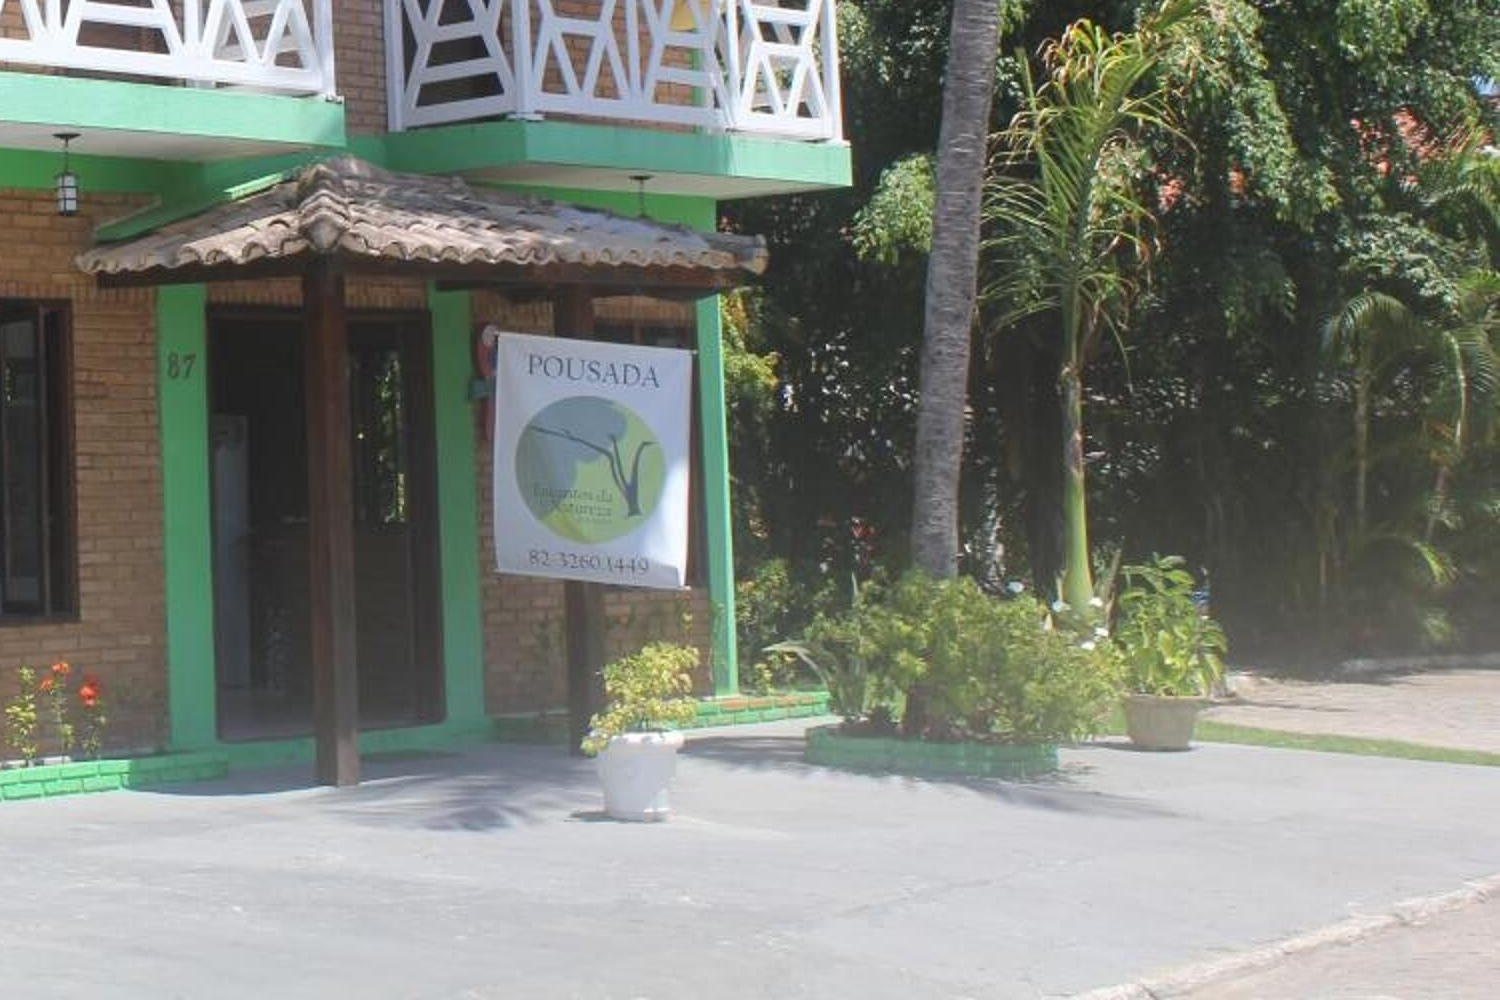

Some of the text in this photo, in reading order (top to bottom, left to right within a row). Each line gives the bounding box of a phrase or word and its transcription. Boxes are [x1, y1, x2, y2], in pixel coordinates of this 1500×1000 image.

[167, 353, 197, 380] 87
[528, 353, 661, 388] POUSADA
[528, 549, 549, 565] 82
